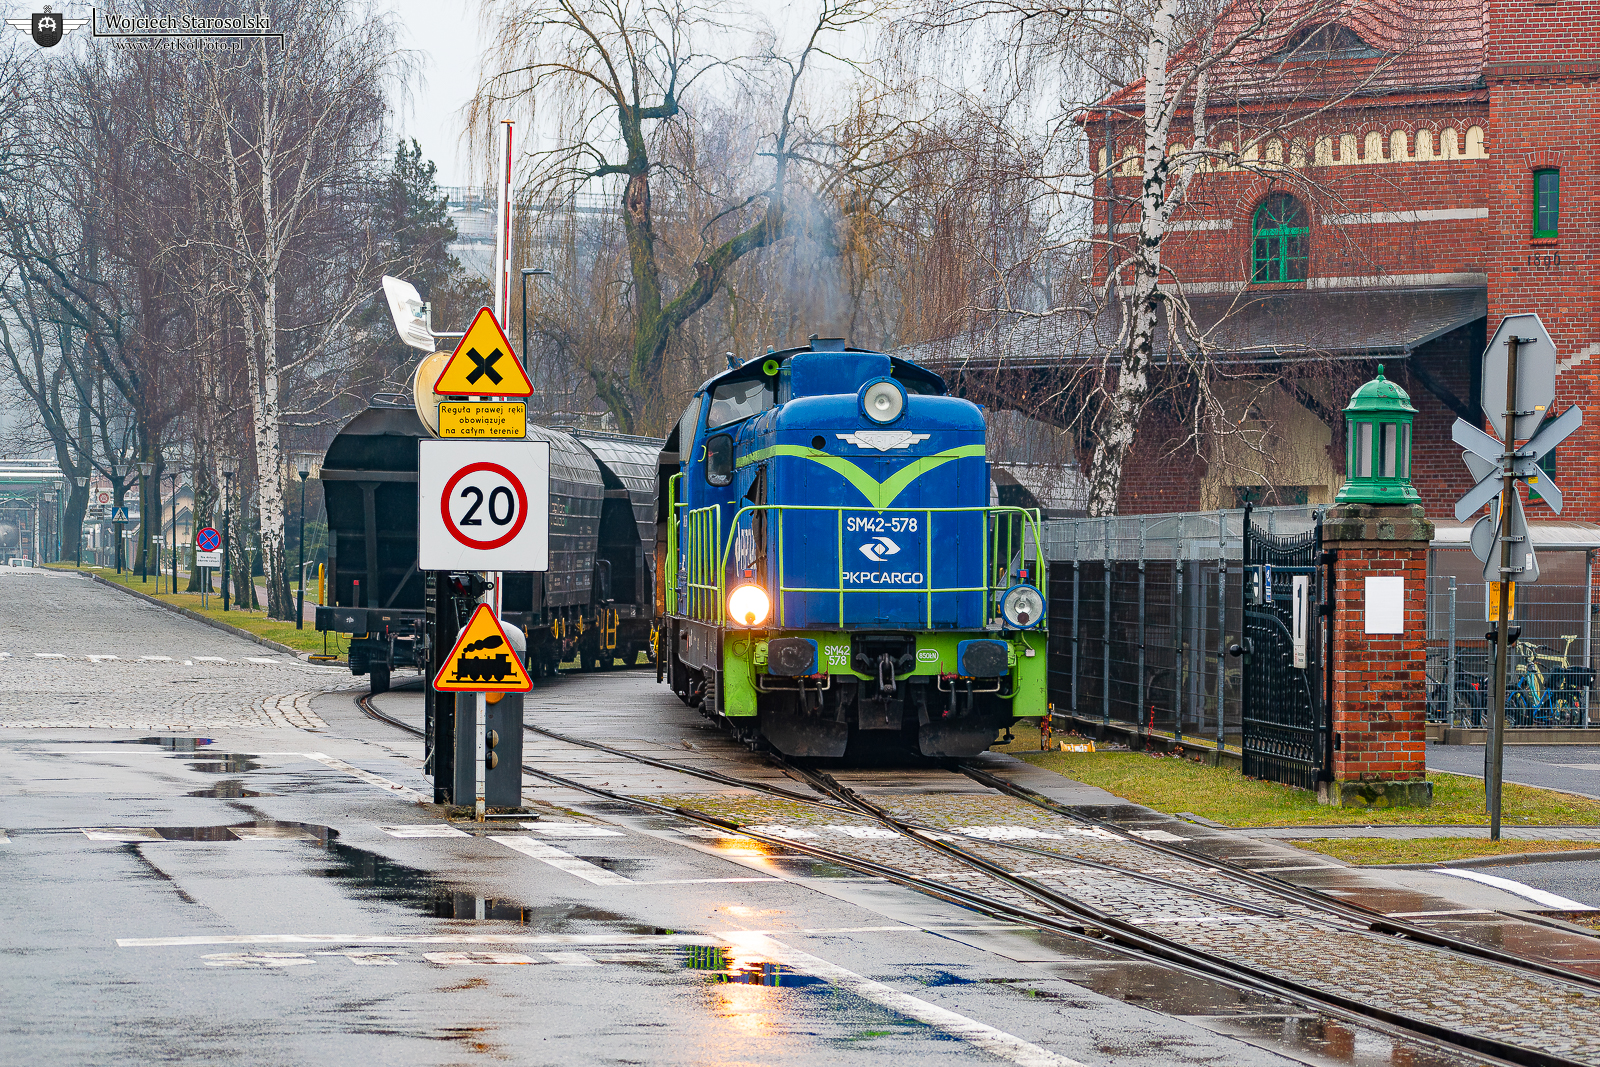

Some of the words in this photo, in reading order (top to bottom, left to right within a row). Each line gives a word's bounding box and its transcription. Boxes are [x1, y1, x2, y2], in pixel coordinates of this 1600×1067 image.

[1527, 250, 1561, 270] 1896
[441, 405, 471, 414] Reguła
[475, 405, 504, 415] prawej
[507, 405, 524, 415] ręki
[459, 416, 506, 426] obowiązuje
[460, 427, 485, 436] całym
[489, 427, 520, 435] terenie
[459, 485, 515, 526] 20
[846, 517, 918, 532] SM42-578
[824, 645, 850, 656] SM42
[828, 656, 847, 666] 578
